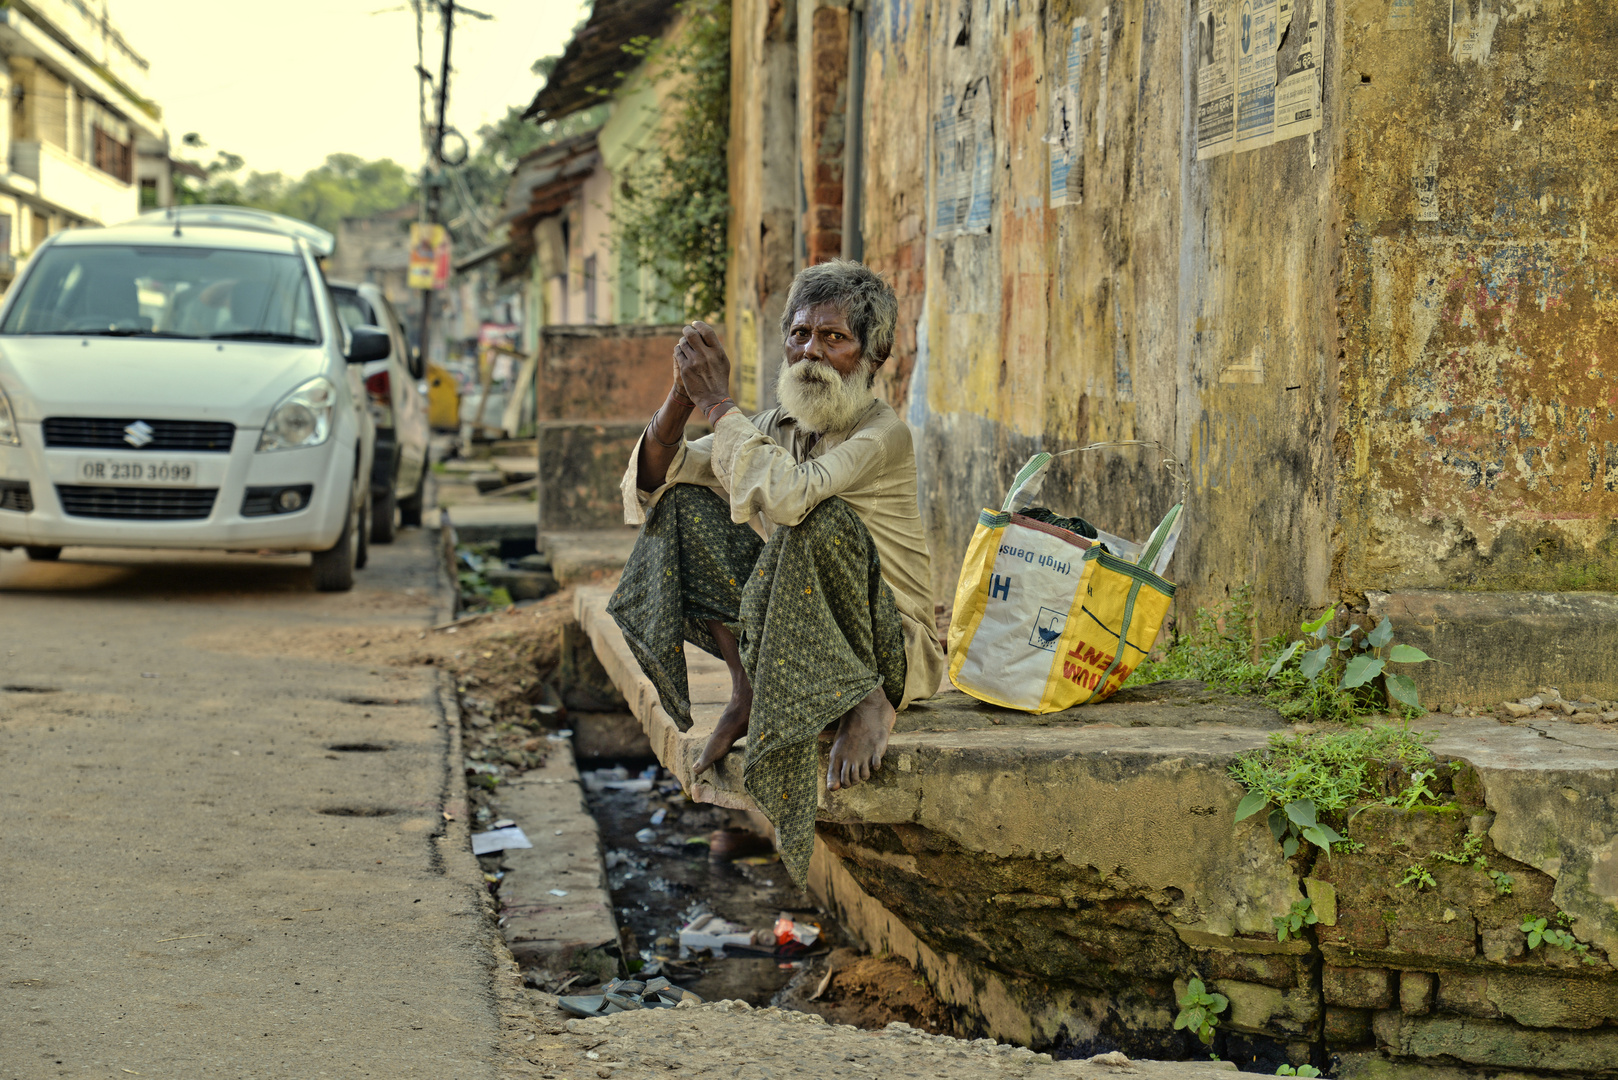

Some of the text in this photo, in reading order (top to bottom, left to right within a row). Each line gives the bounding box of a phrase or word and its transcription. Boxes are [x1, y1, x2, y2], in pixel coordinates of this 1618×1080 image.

[83, 462, 191, 481] OR 23D 3099
[998, 544, 1071, 575] (High Densi
